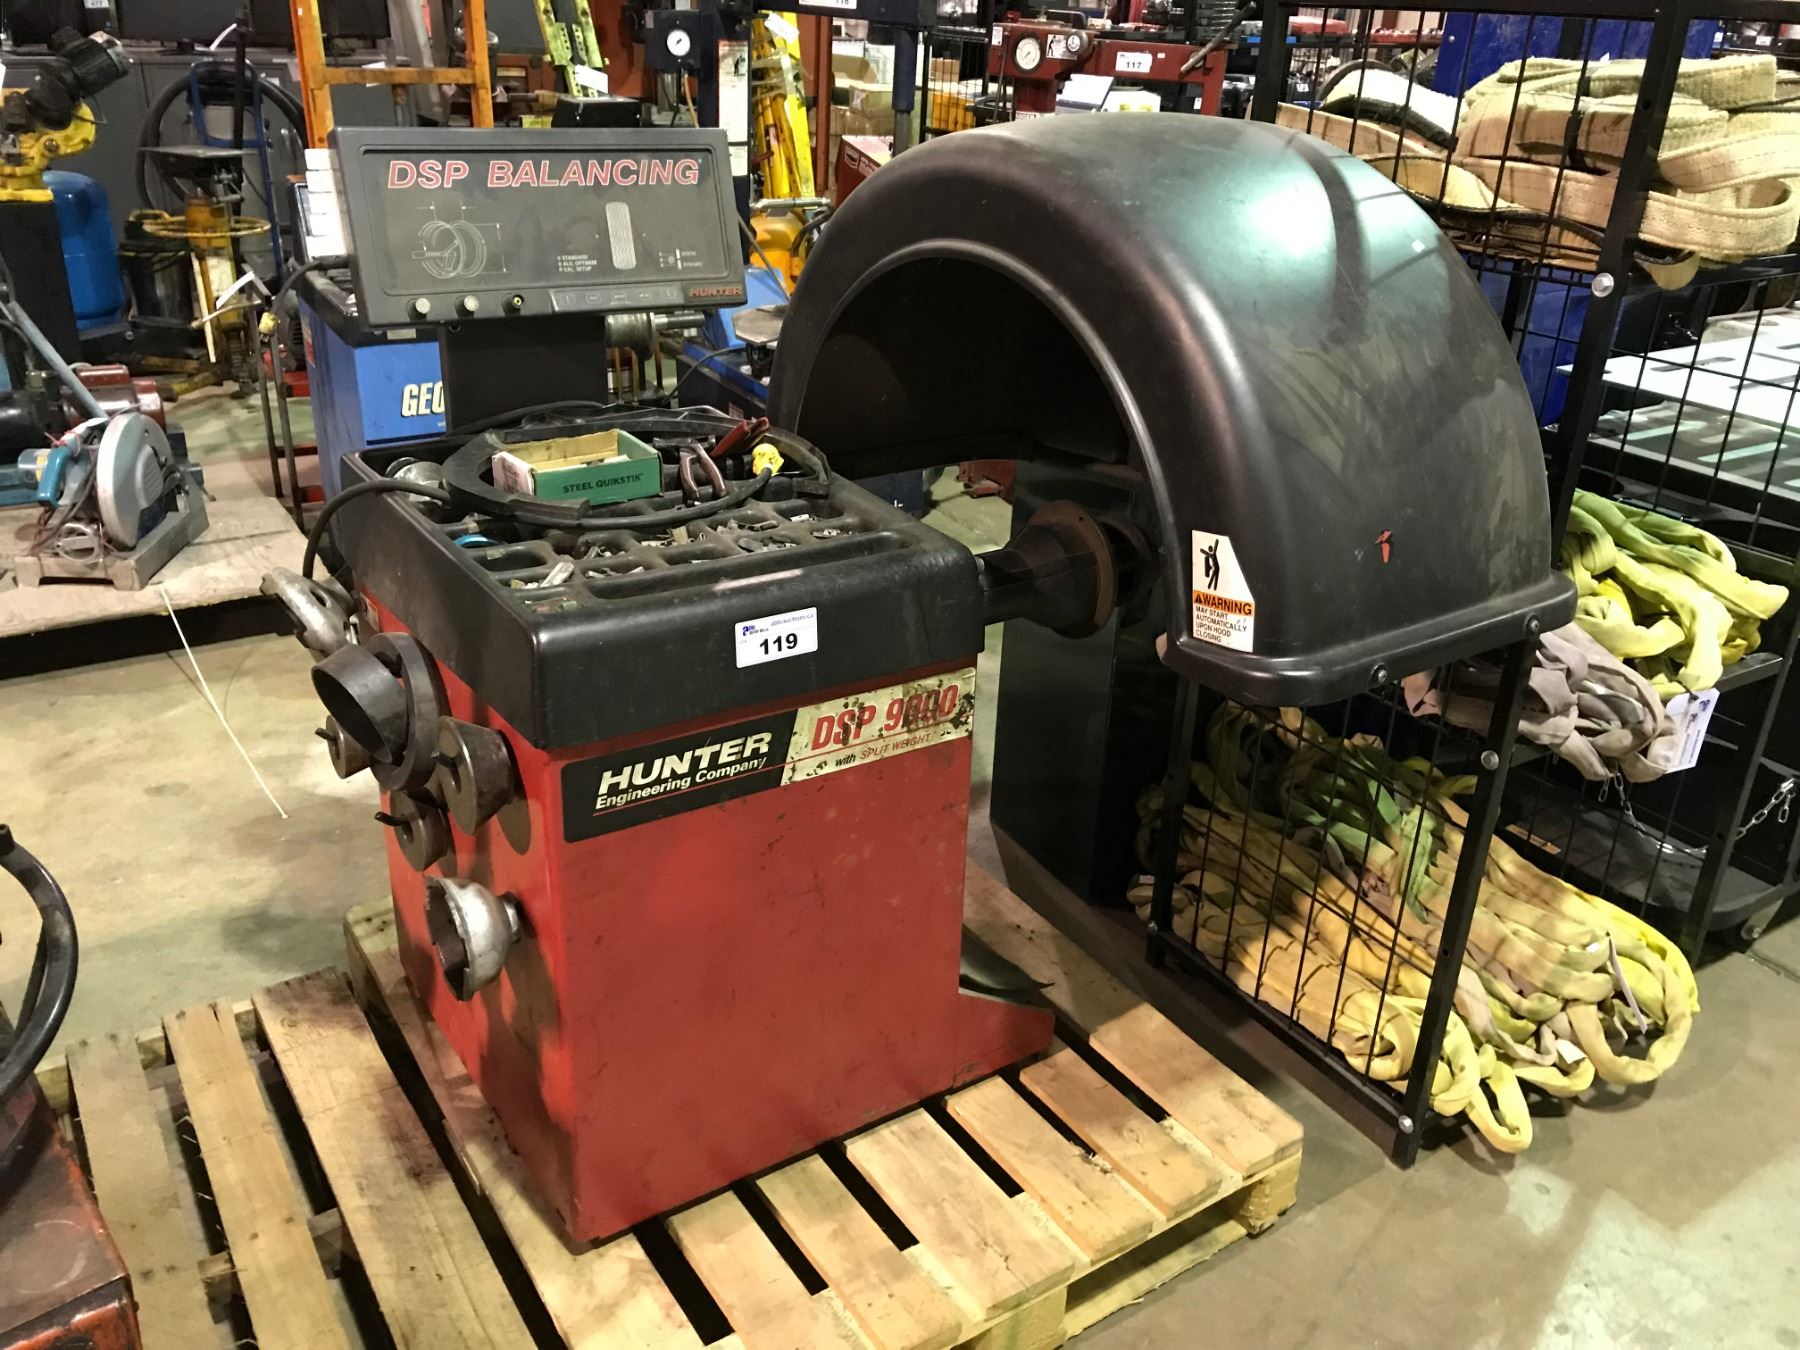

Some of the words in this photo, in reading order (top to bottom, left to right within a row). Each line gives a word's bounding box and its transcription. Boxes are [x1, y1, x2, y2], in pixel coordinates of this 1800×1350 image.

[1126, 61, 1142, 69] 117
[388, 160, 469, 189] DSP
[488, 158, 699, 188] BALANCING
[688, 286, 742, 297] HUNTER
[563, 481, 593, 494] STEEL
[595, 474, 642, 487] QUIKSTIK
[1195, 605, 1208, 614] MAY
[1209, 609, 1228, 619] START
[1202, 593, 1252, 616] WARNING
[1195, 613, 1247, 632] AUTOMATICALLY
[1195, 621, 1213, 632] UPON
[1213, 626, 1231, 637] HOOD
[760, 633, 798, 655] 119
[1195, 629, 1222, 642] CLOSING
[811, 704, 877, 751] DSP
[883, 684, 960, 732] 9000
[598, 731, 773, 795] HUNTER
[835, 753, 857, 768] with
[860, 744, 893, 760] SPLIT
[595, 775, 691, 810] Engineering
[695, 756, 767, 783] Company
